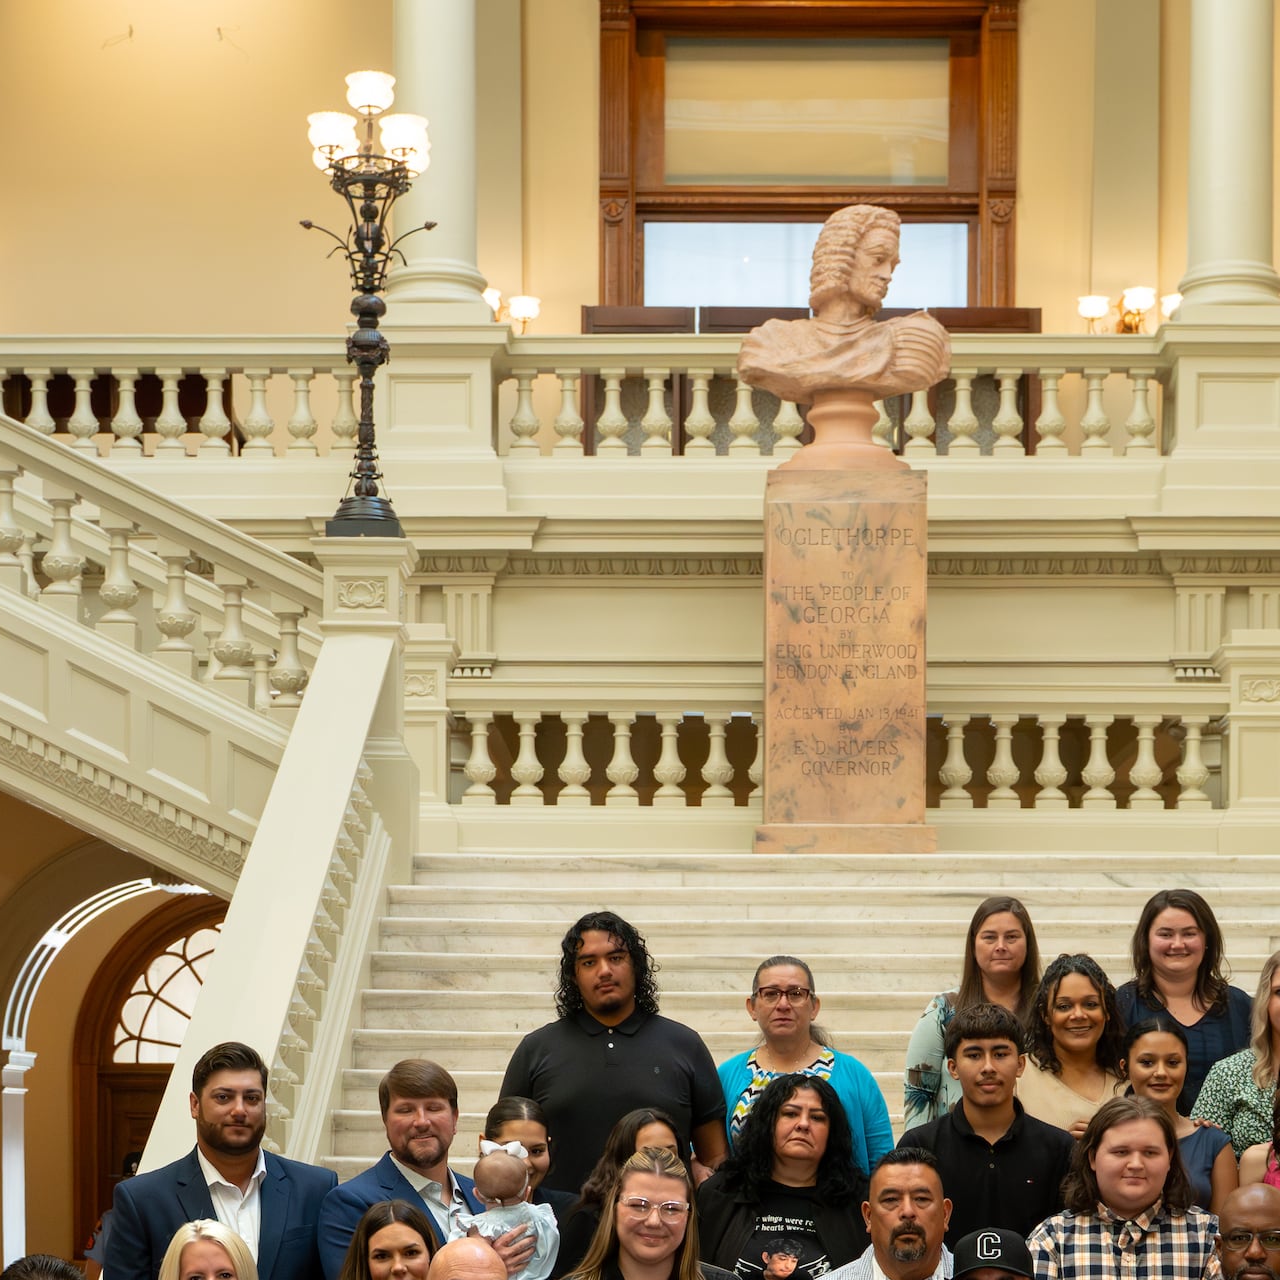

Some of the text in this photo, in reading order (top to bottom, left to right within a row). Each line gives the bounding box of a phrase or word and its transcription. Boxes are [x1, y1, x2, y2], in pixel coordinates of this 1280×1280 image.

[780, 528, 914, 546] OGLETHORPE
[841, 571, 854, 580] TO
[782, 586, 912, 601] THE PEOPLE OF
[803, 606, 890, 624] GEORGIA
[840, 629, 853, 639] BY
[775, 644, 917, 659] ERIC UNDERWOOD
[846, 664, 917, 680] ENGLAND
[775, 707, 842, 720] ACCEPTED
[895, 707, 920, 720] 1941
[838, 740, 899, 756] RIVERS
[801, 760, 892, 776] GOVERNOR
[761, 1214, 783, 1223] wings
[785, 1216, 803, 1225] were
[761, 1223, 784, 1231] hearts
[977, 1232, 1001, 1259] C
